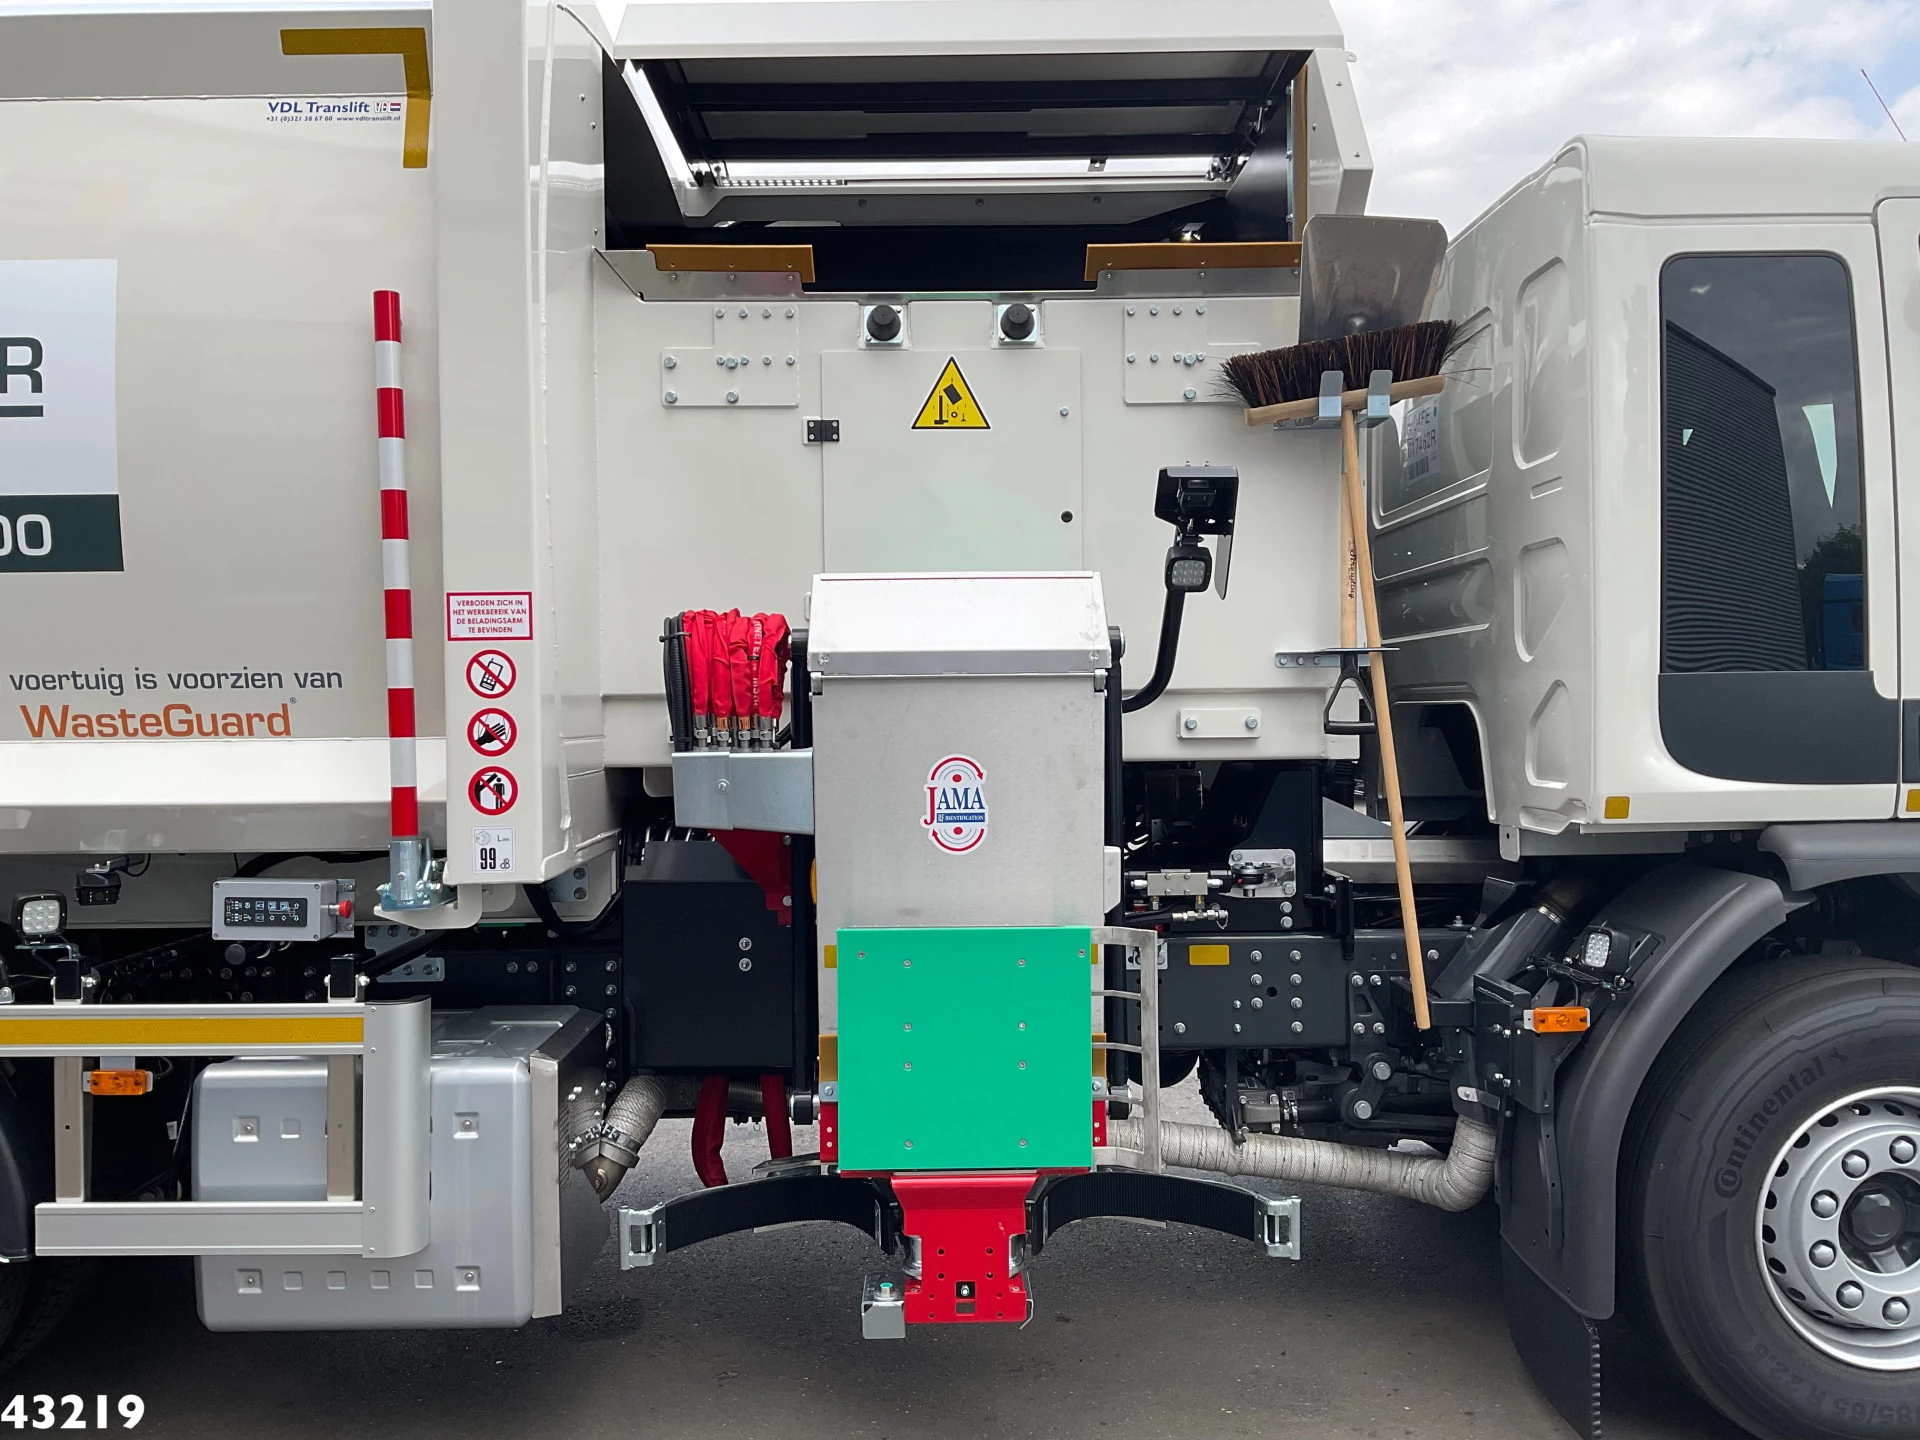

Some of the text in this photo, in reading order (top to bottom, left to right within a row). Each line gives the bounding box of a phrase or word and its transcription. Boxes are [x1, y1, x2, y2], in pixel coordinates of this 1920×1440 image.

[268, 101, 303, 113] VDL
[306, 101, 370, 113] Translift
[280, 115, 302, 123] (0)321
[9, 667, 343, 696] voertuig is voorzien van
[924, 787, 985, 825] JAMA
[480, 847, 496, 870] 99
[1714, 1056, 1826, 1198] Continental
